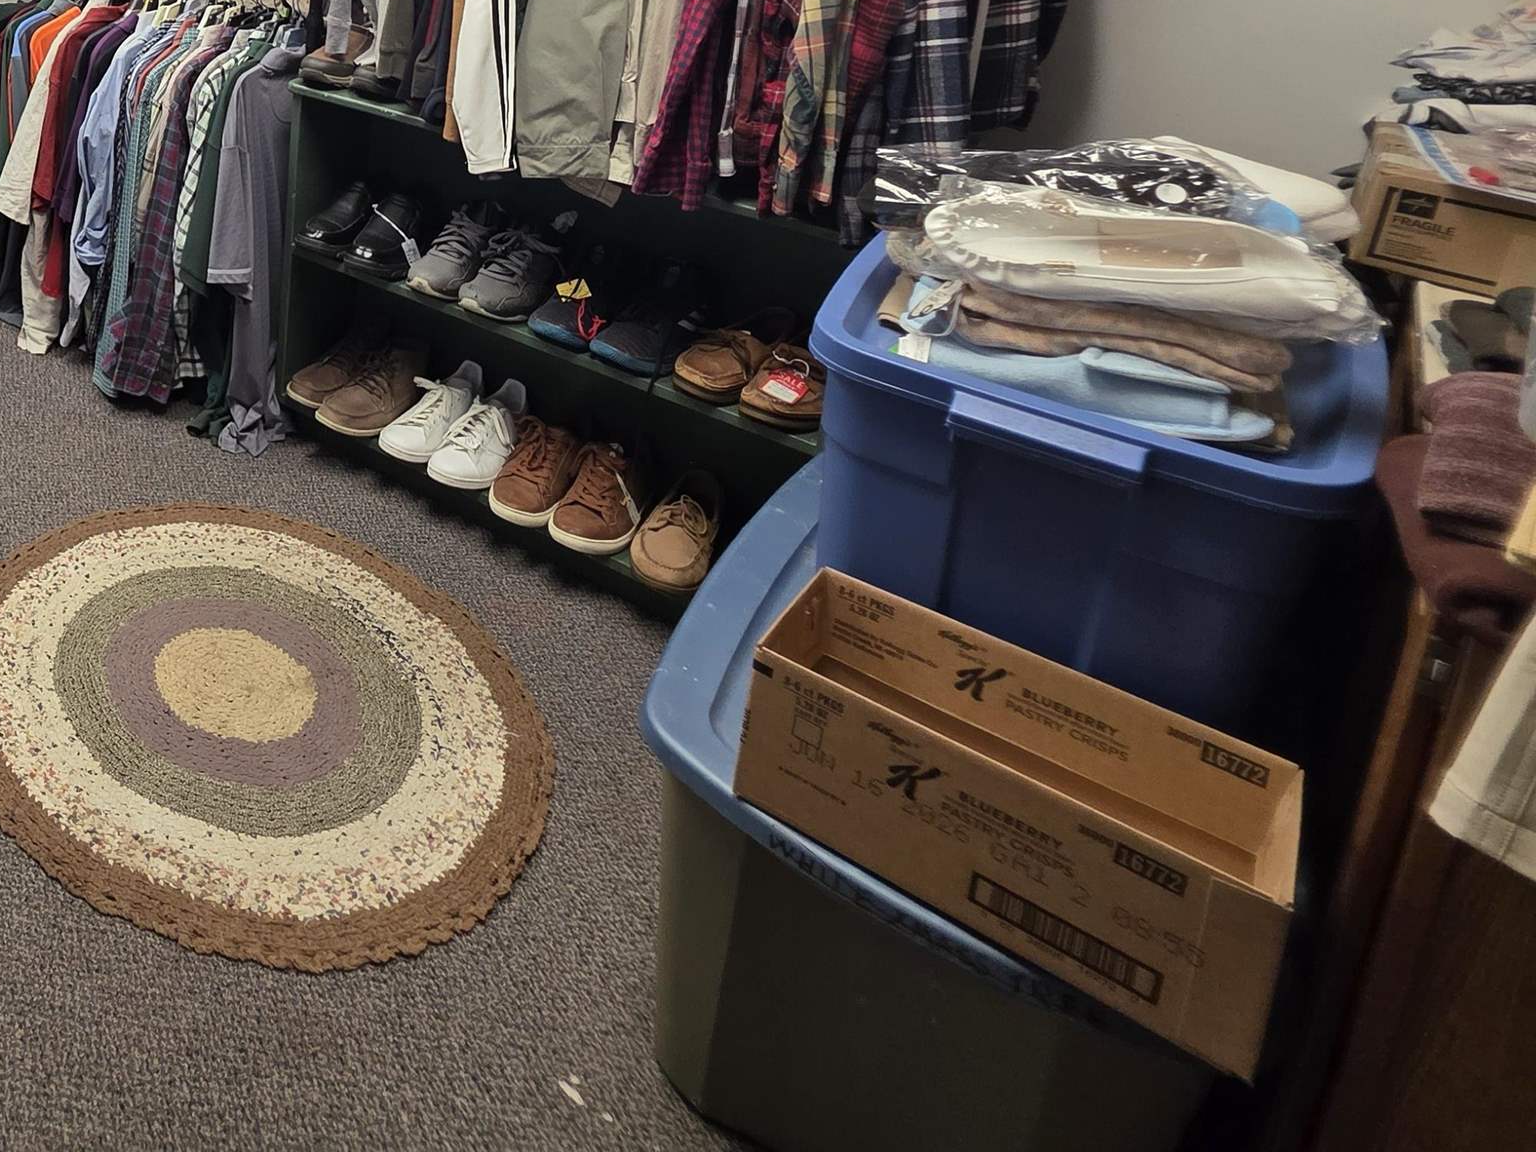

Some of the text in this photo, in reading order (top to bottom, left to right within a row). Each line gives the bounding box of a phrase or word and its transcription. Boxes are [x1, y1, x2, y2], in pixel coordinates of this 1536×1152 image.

[1392, 215, 1457, 237] FRAGILE
[954, 667, 1008, 702] K
[1005, 699, 1129, 762] PASTRY CRISPS
[1021, 687, 1120, 737] BLUEBERRY
[886, 765, 942, 801] K
[1204, 746, 1266, 786] 16772
[941, 801, 1075, 878] PASTRY CRISPS
[959, 791, 1064, 849] BLUEBERRY
[1117, 848, 1185, 891] 16772
